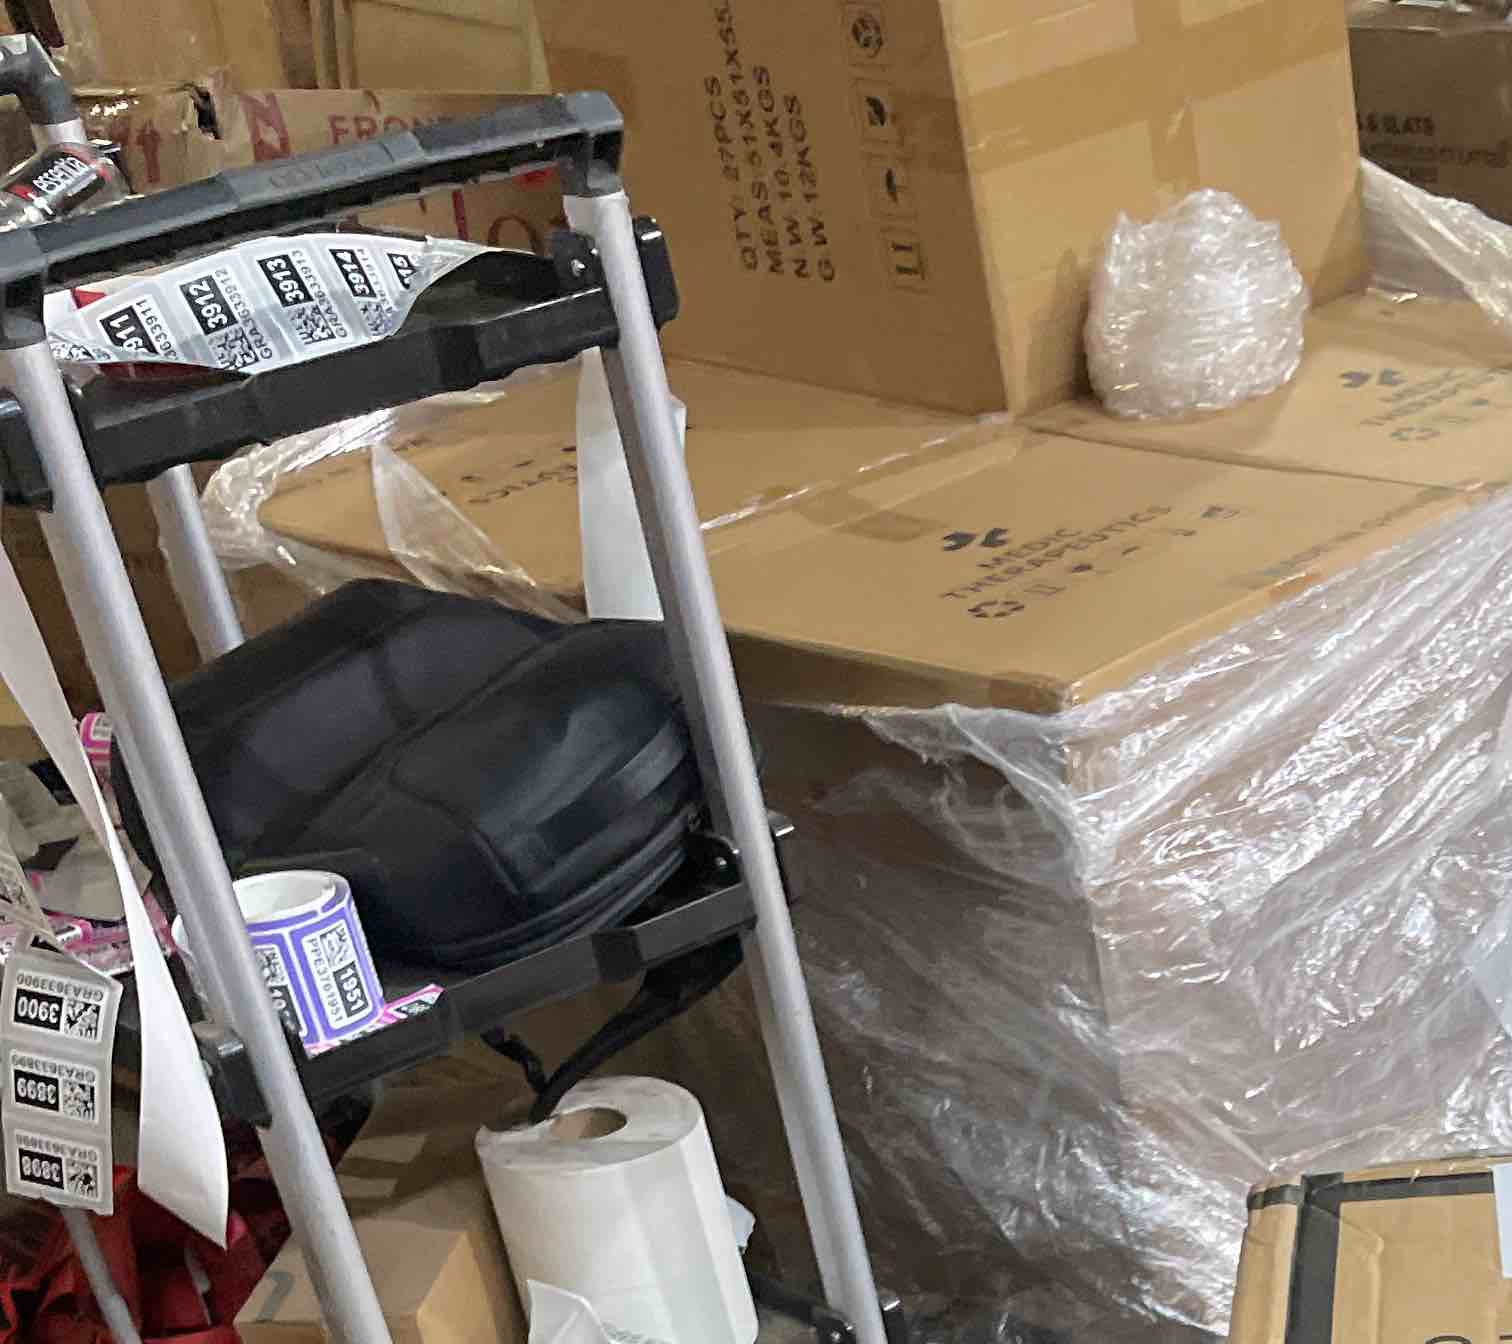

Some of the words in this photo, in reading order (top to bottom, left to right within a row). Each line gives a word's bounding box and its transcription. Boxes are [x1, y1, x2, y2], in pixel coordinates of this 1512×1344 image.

[189, 278, 229, 330] 3912
[267, 256, 305, 306] 3913
[17, 996, 60, 1024] 3900
[339, 968, 366, 1013] 1951
